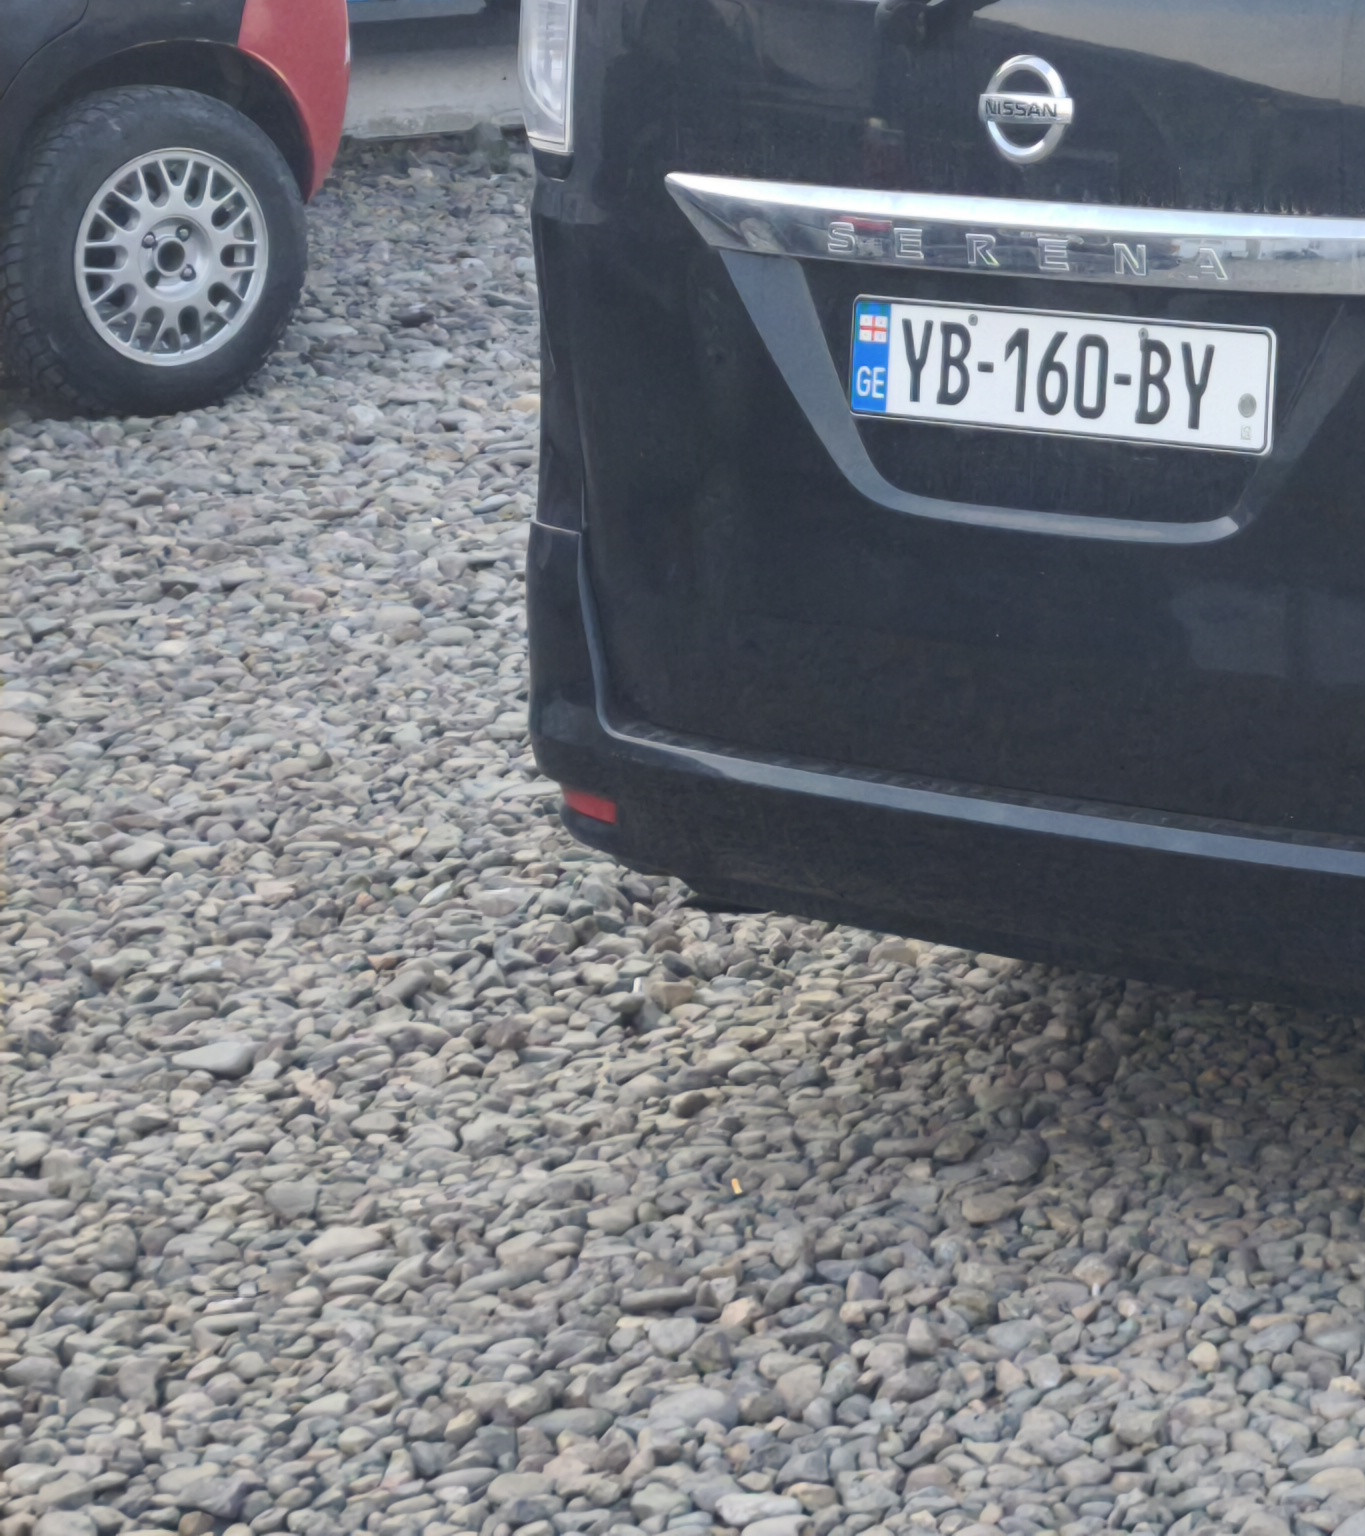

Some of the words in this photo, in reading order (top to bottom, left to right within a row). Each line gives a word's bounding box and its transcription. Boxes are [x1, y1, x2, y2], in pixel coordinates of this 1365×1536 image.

[985, 98, 1058, 118] NISSAN
[827, 221, 1229, 281] SERENA
[855, 365, 886, 400] GE
[900, 317, 1218, 431] YB-160-BY
